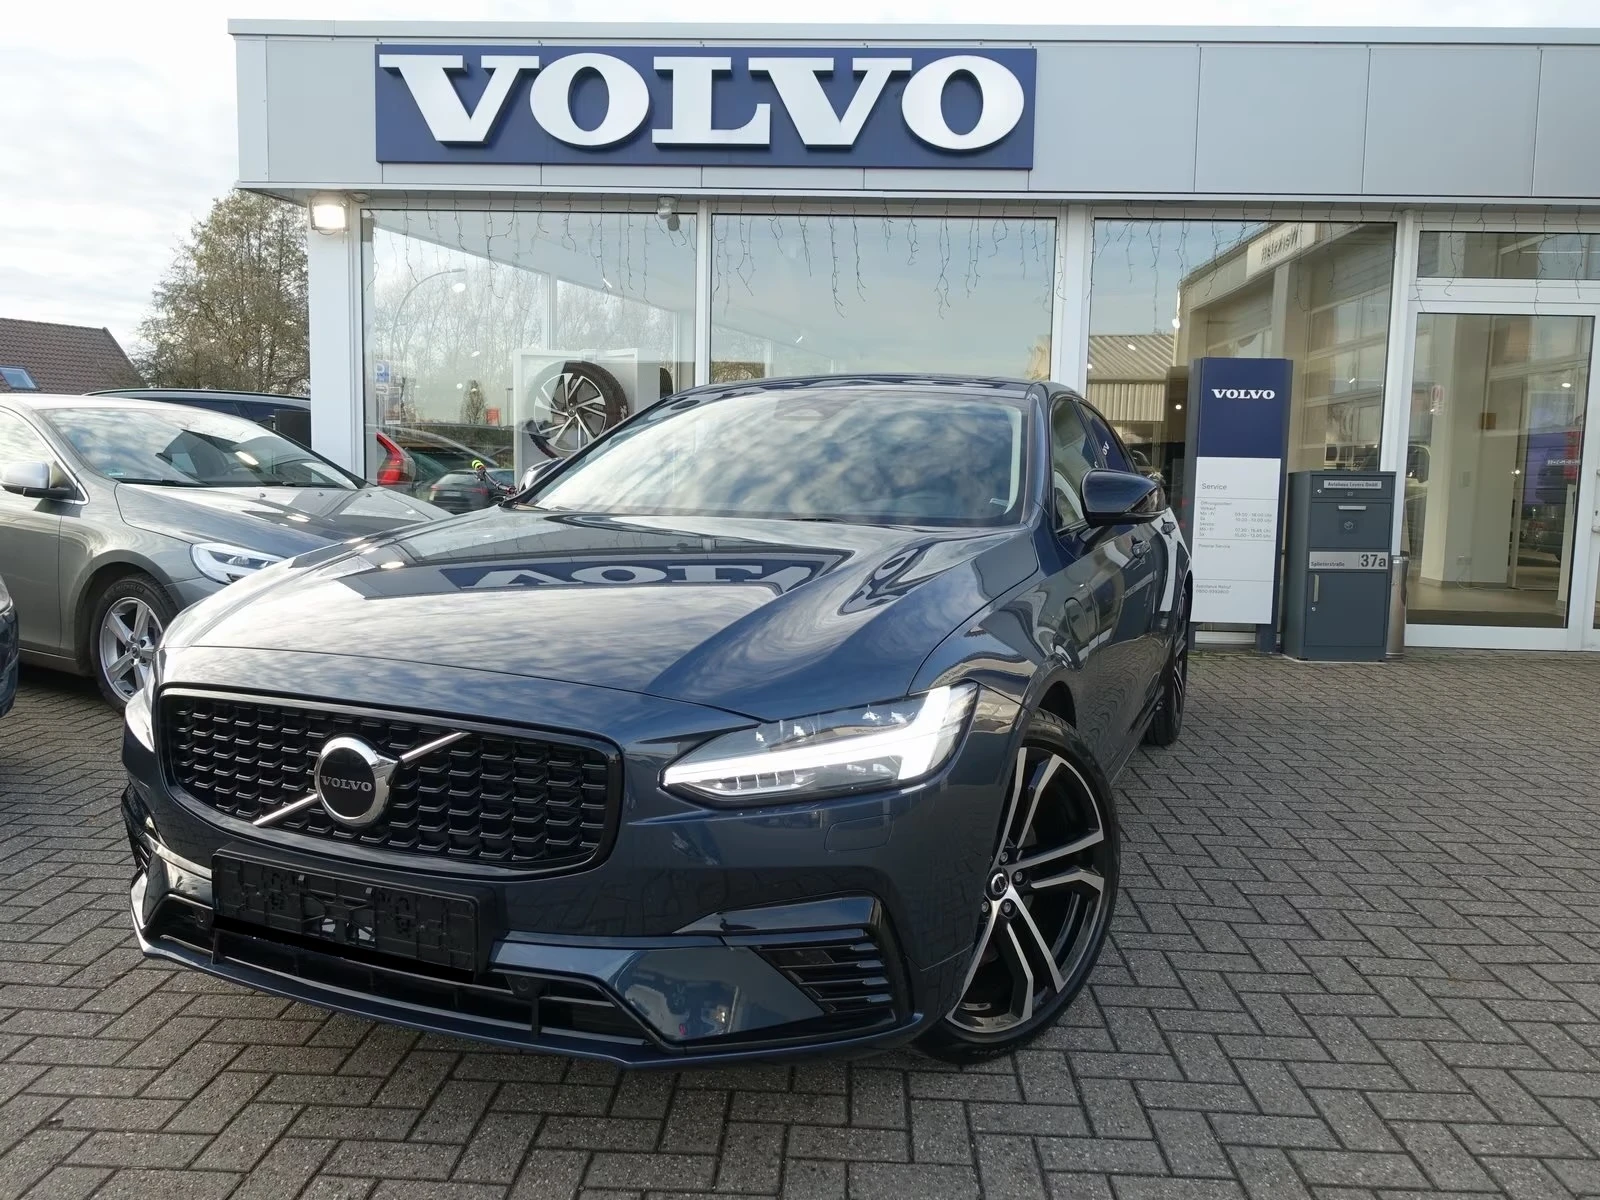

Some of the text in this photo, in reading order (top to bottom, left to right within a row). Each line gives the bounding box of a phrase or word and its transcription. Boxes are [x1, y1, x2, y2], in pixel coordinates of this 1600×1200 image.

[379, 52, 1024, 150] VOLVO
[1211, 388, 1275, 400] VOLVO
[1360, 554, 1386, 567] 37a
[320, 775, 373, 792] VOLVO
